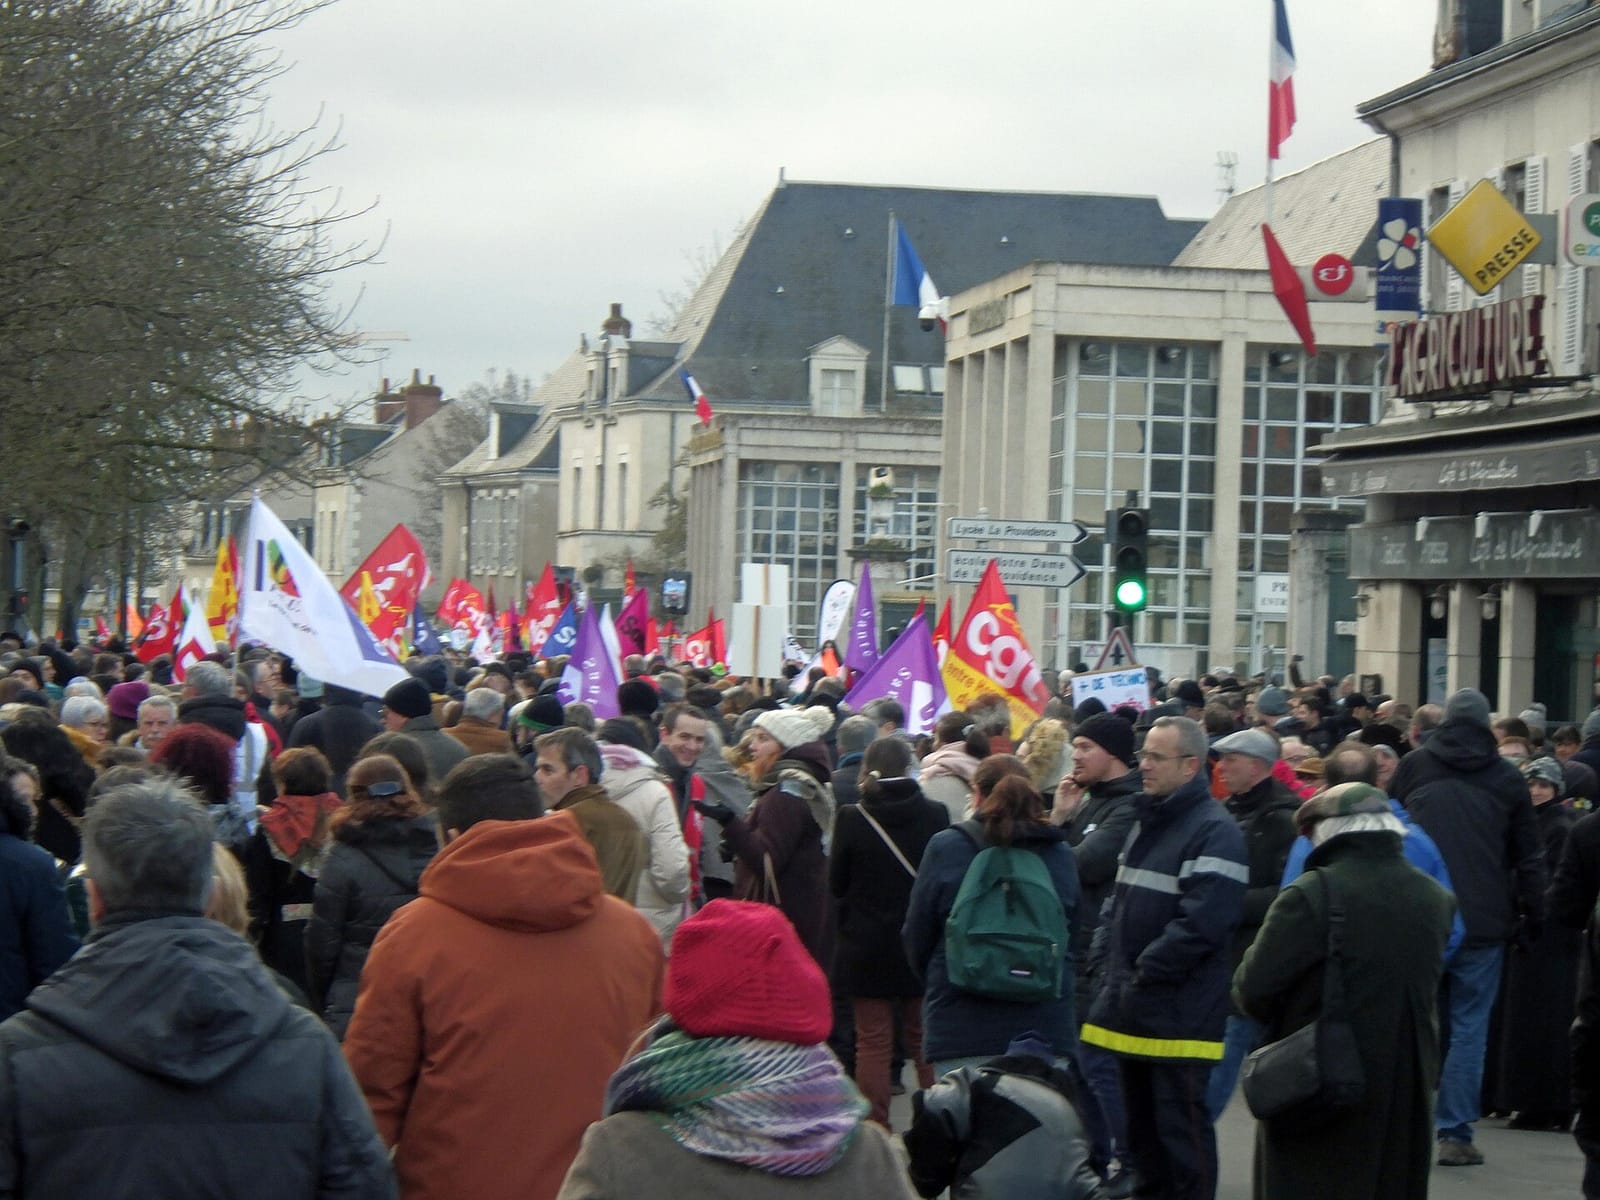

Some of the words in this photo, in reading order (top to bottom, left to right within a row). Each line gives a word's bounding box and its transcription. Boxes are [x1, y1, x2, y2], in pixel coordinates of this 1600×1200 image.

[1475, 228, 1534, 285] PRESSE
[988, 525, 1001, 535] La
[1004, 525, 1057, 537] Providence
[1031, 558, 1066, 569] Dame
[953, 568, 968, 578] de
